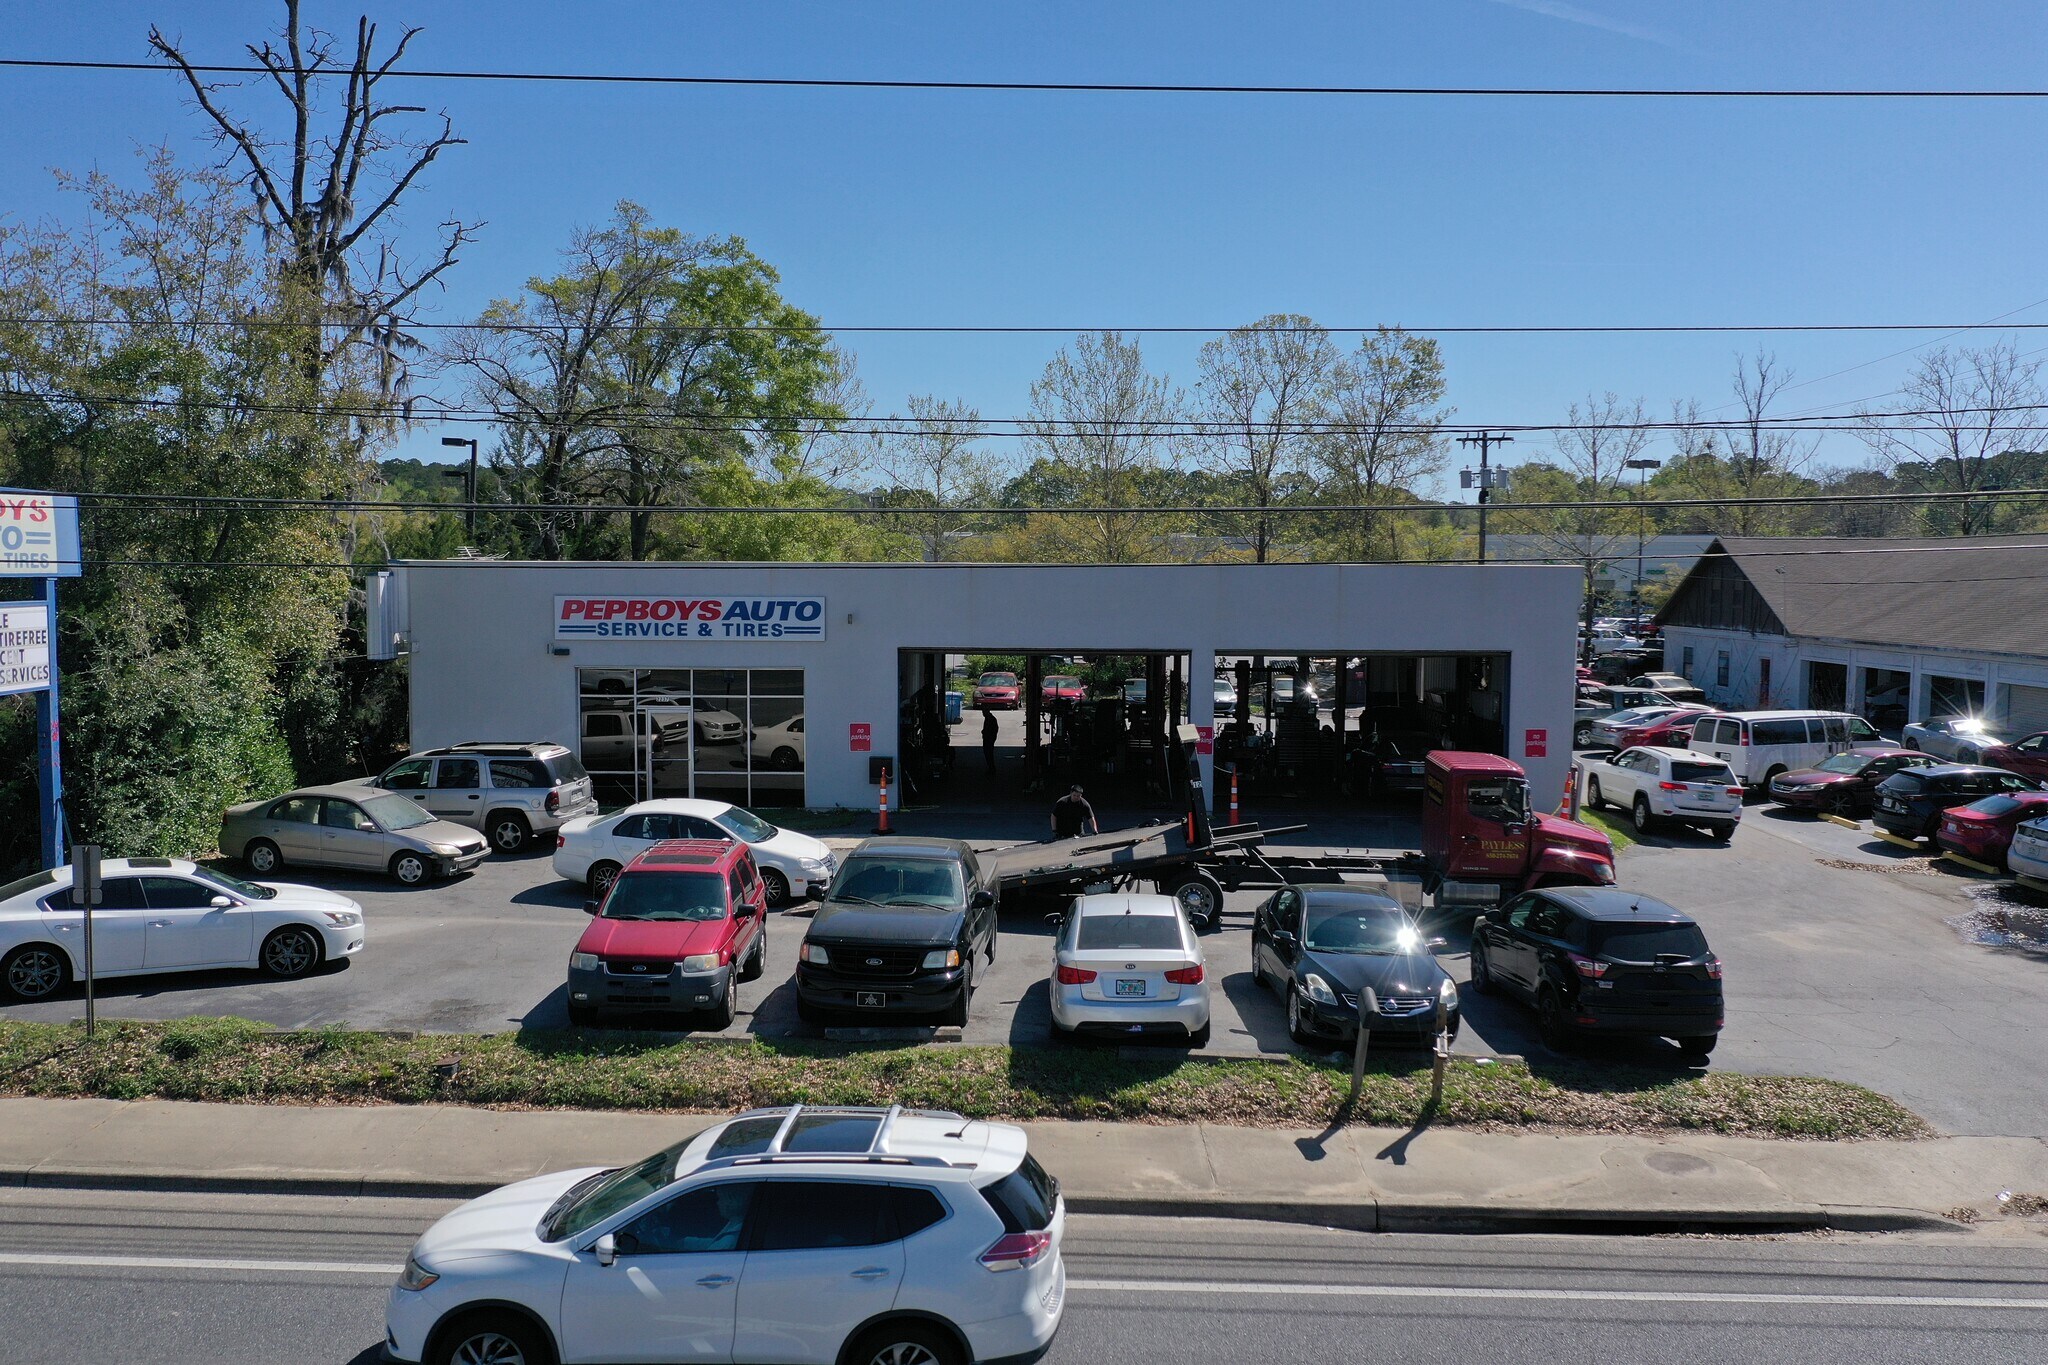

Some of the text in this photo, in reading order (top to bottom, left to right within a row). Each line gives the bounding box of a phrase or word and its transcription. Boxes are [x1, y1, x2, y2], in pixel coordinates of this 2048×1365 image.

[4, 552, 50, 569] TIRES
[597, 622, 783, 637] SERVICE & TIRES
[0, 665, 49, 684] SERVICES
[1481, 841, 1525, 850] PAYLESS
